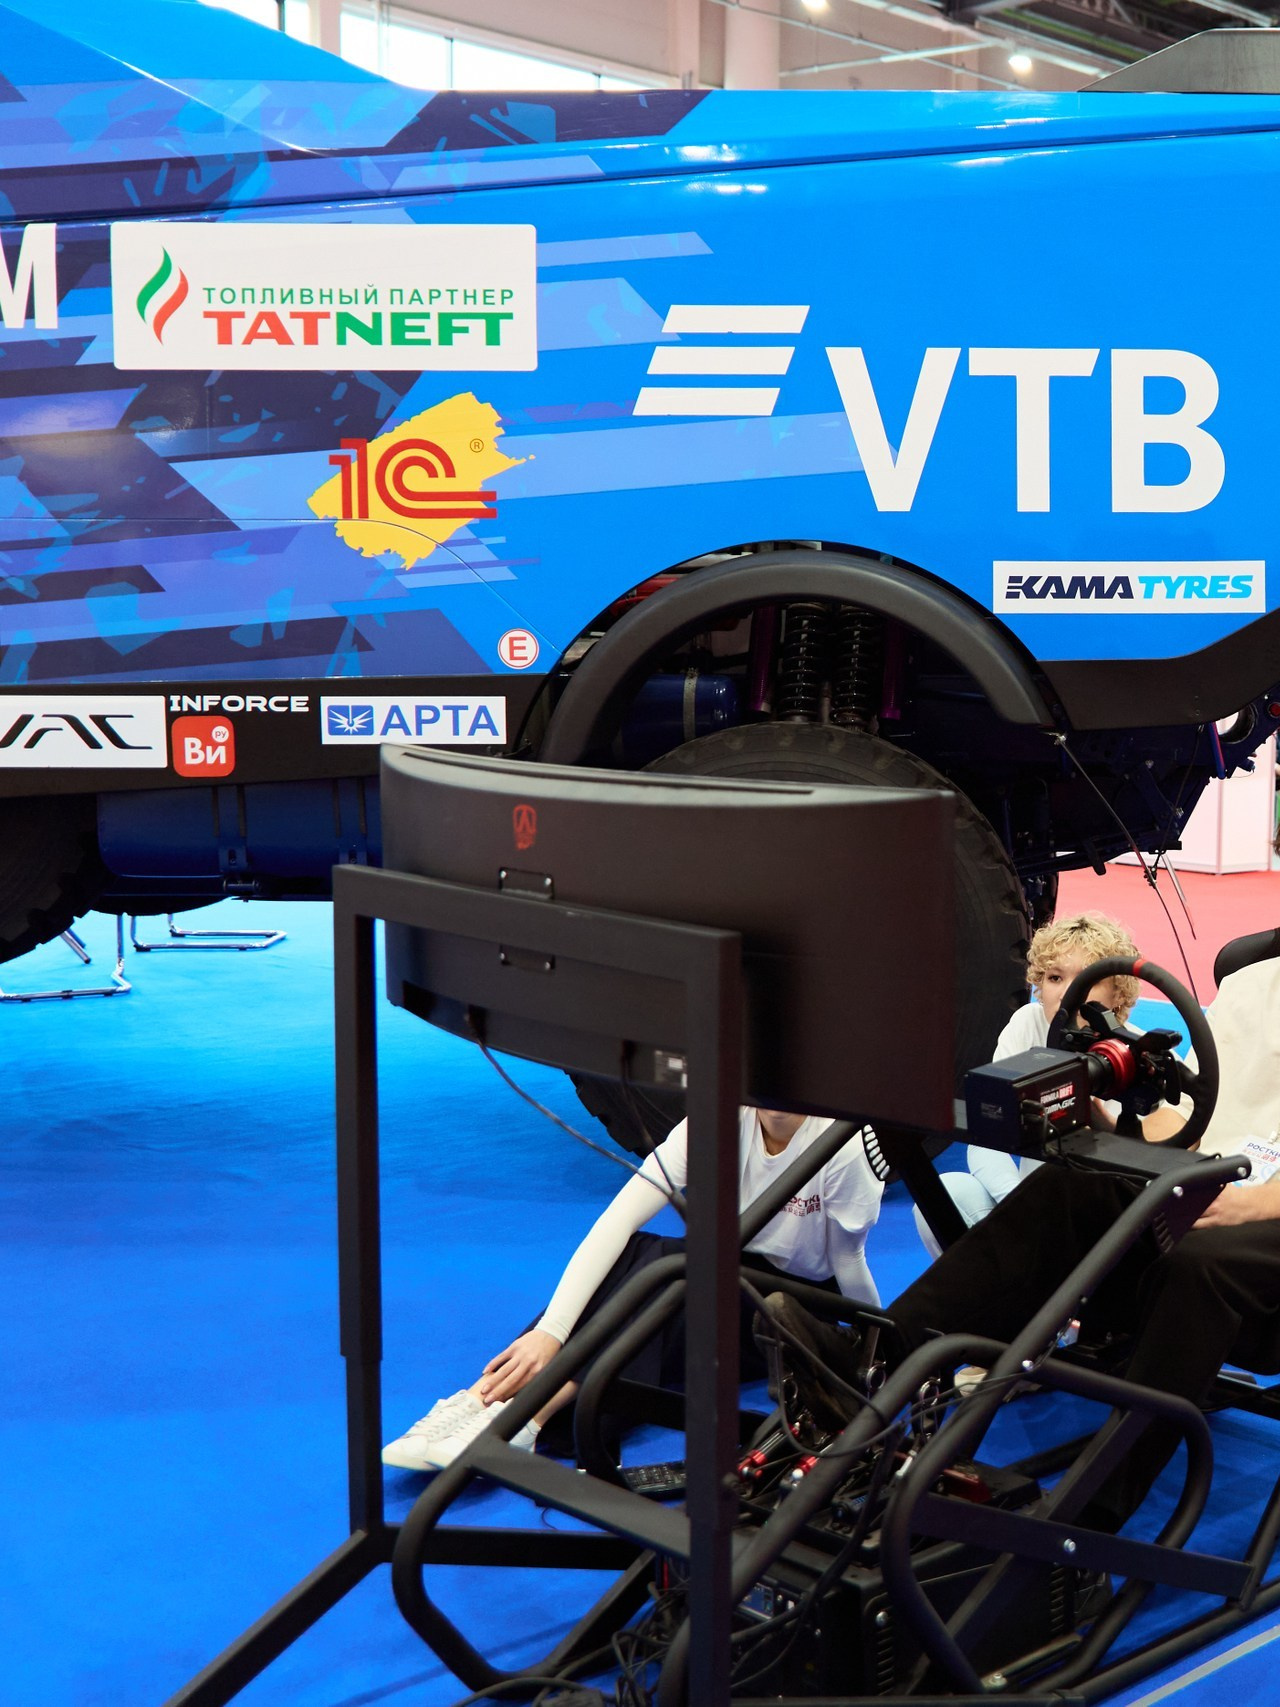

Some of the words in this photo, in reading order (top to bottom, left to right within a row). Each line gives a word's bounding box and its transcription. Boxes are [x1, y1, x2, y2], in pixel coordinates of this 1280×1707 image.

[202, 283, 379, 305] ТОПЛИВНЫЙ
[389, 288, 514, 306] ПАРТНЕР
[202, 311, 514, 346] TATNEFT
[825, 346, 1226, 513] VTB
[1005, 575, 1134, 600] KAMA
[1137, 575, 1254, 600] TYRES
[508, 636, 529, 661] E
[169, 694, 310, 713] INFORCE
[379, 704, 500, 737] АРТА
[184, 736, 227, 765] Ви
[789, 1194, 821, 1208] ОСТК
